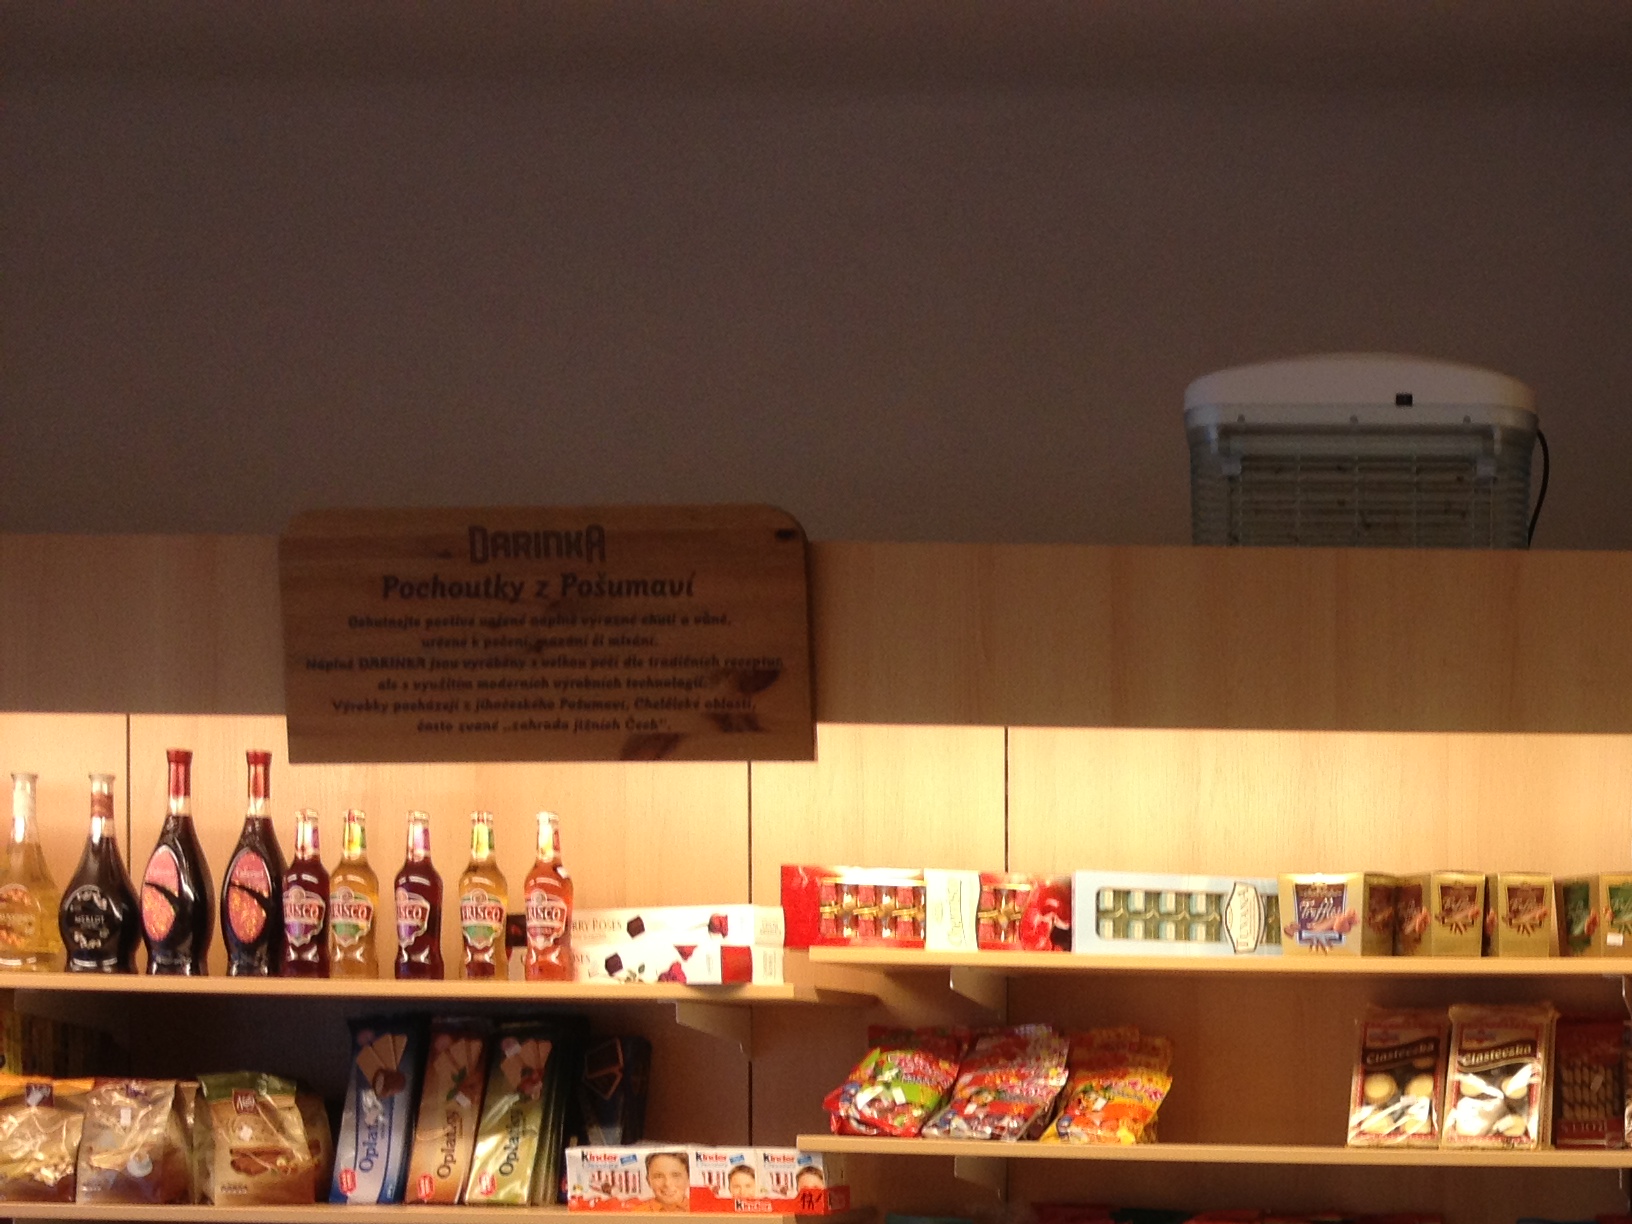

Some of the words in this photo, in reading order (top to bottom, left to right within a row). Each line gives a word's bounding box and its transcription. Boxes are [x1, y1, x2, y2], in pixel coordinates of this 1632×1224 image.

[469, 525, 606, 564] DARINKA
[383, 573, 524, 603] Pochoutky
[536, 579, 549, 597] z
[561, 571, 696, 597] Pošumaví
[286, 904, 319, 920] RISCO
[397, 904, 423, 920] ISCO
[462, 904, 502, 921] FRISCO
[528, 904, 562, 920] RISCO
